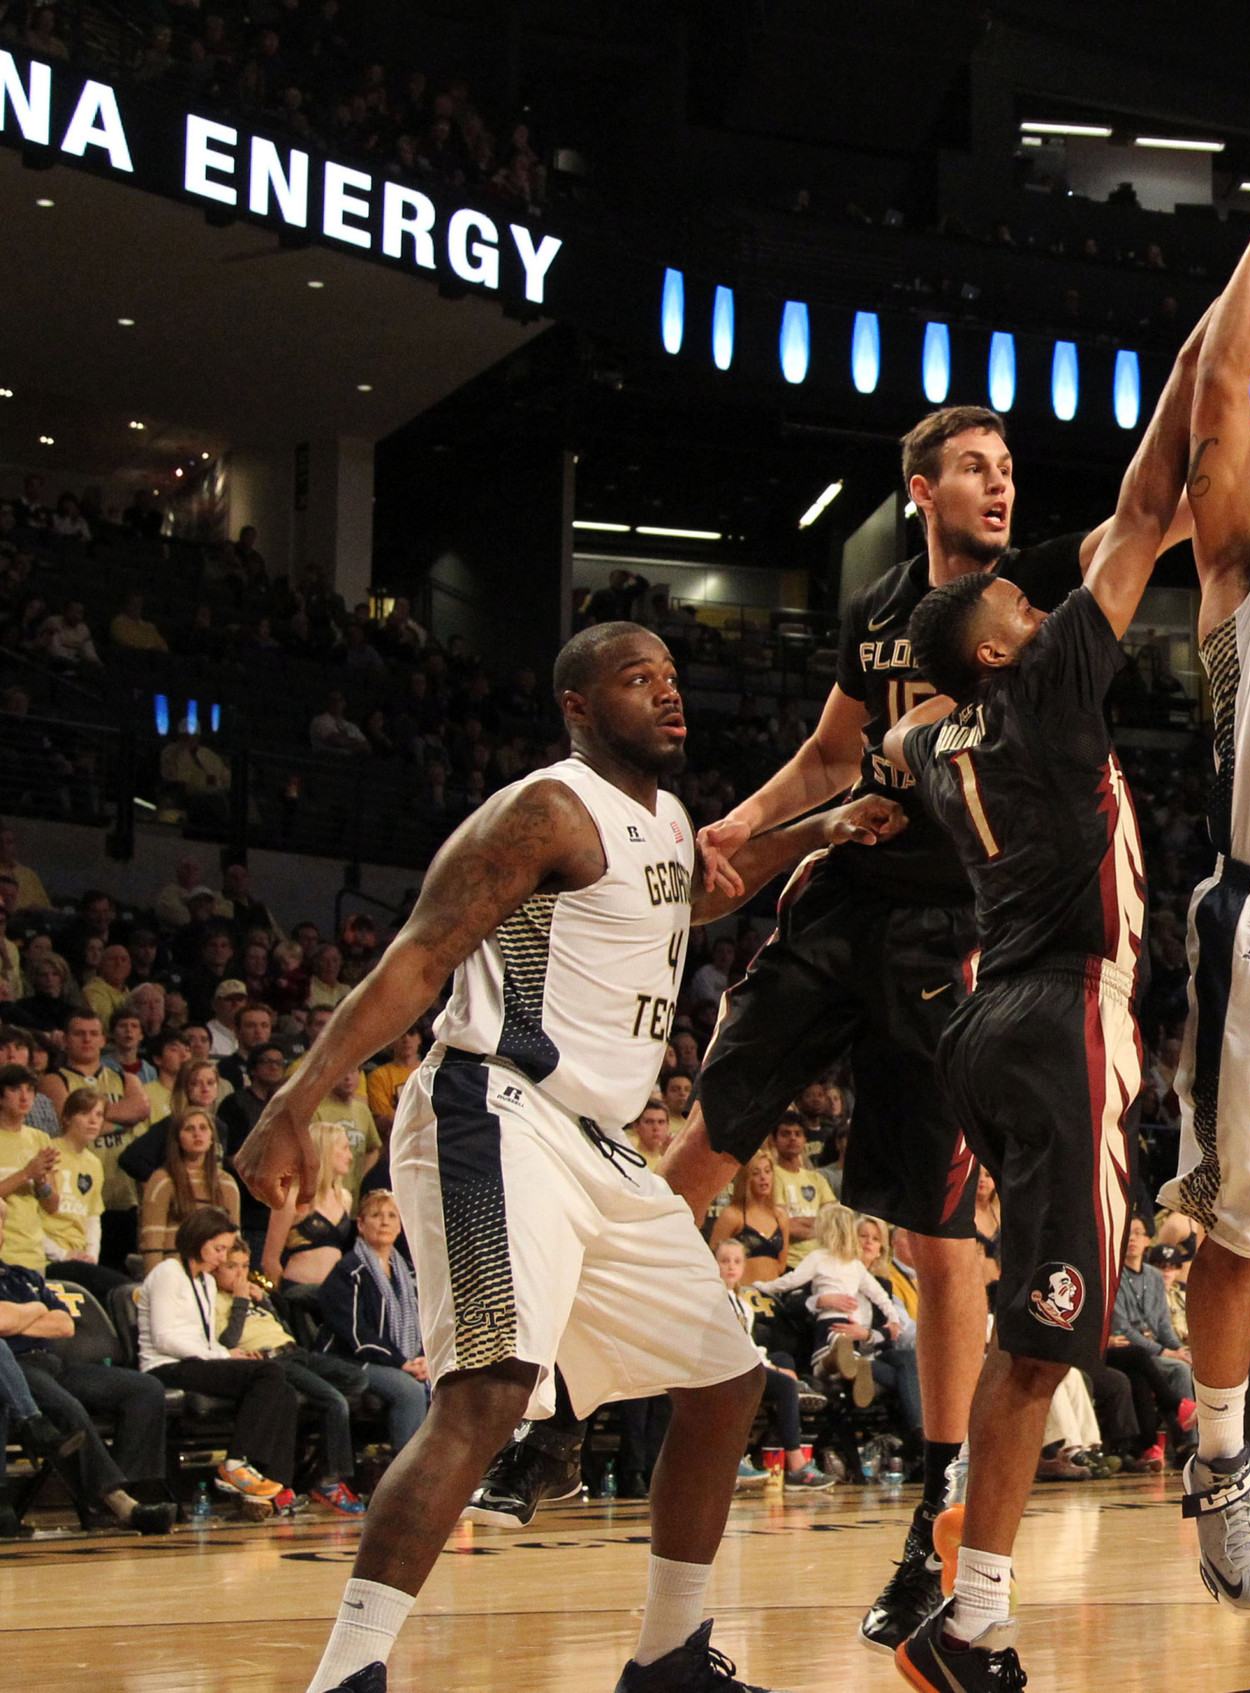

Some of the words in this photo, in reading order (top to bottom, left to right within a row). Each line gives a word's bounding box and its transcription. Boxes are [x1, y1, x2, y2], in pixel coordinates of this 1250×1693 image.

[184, 113, 563, 304] ENERGY
[951, 748, 1001, 859] 1
[668, 928, 684, 986] 4
